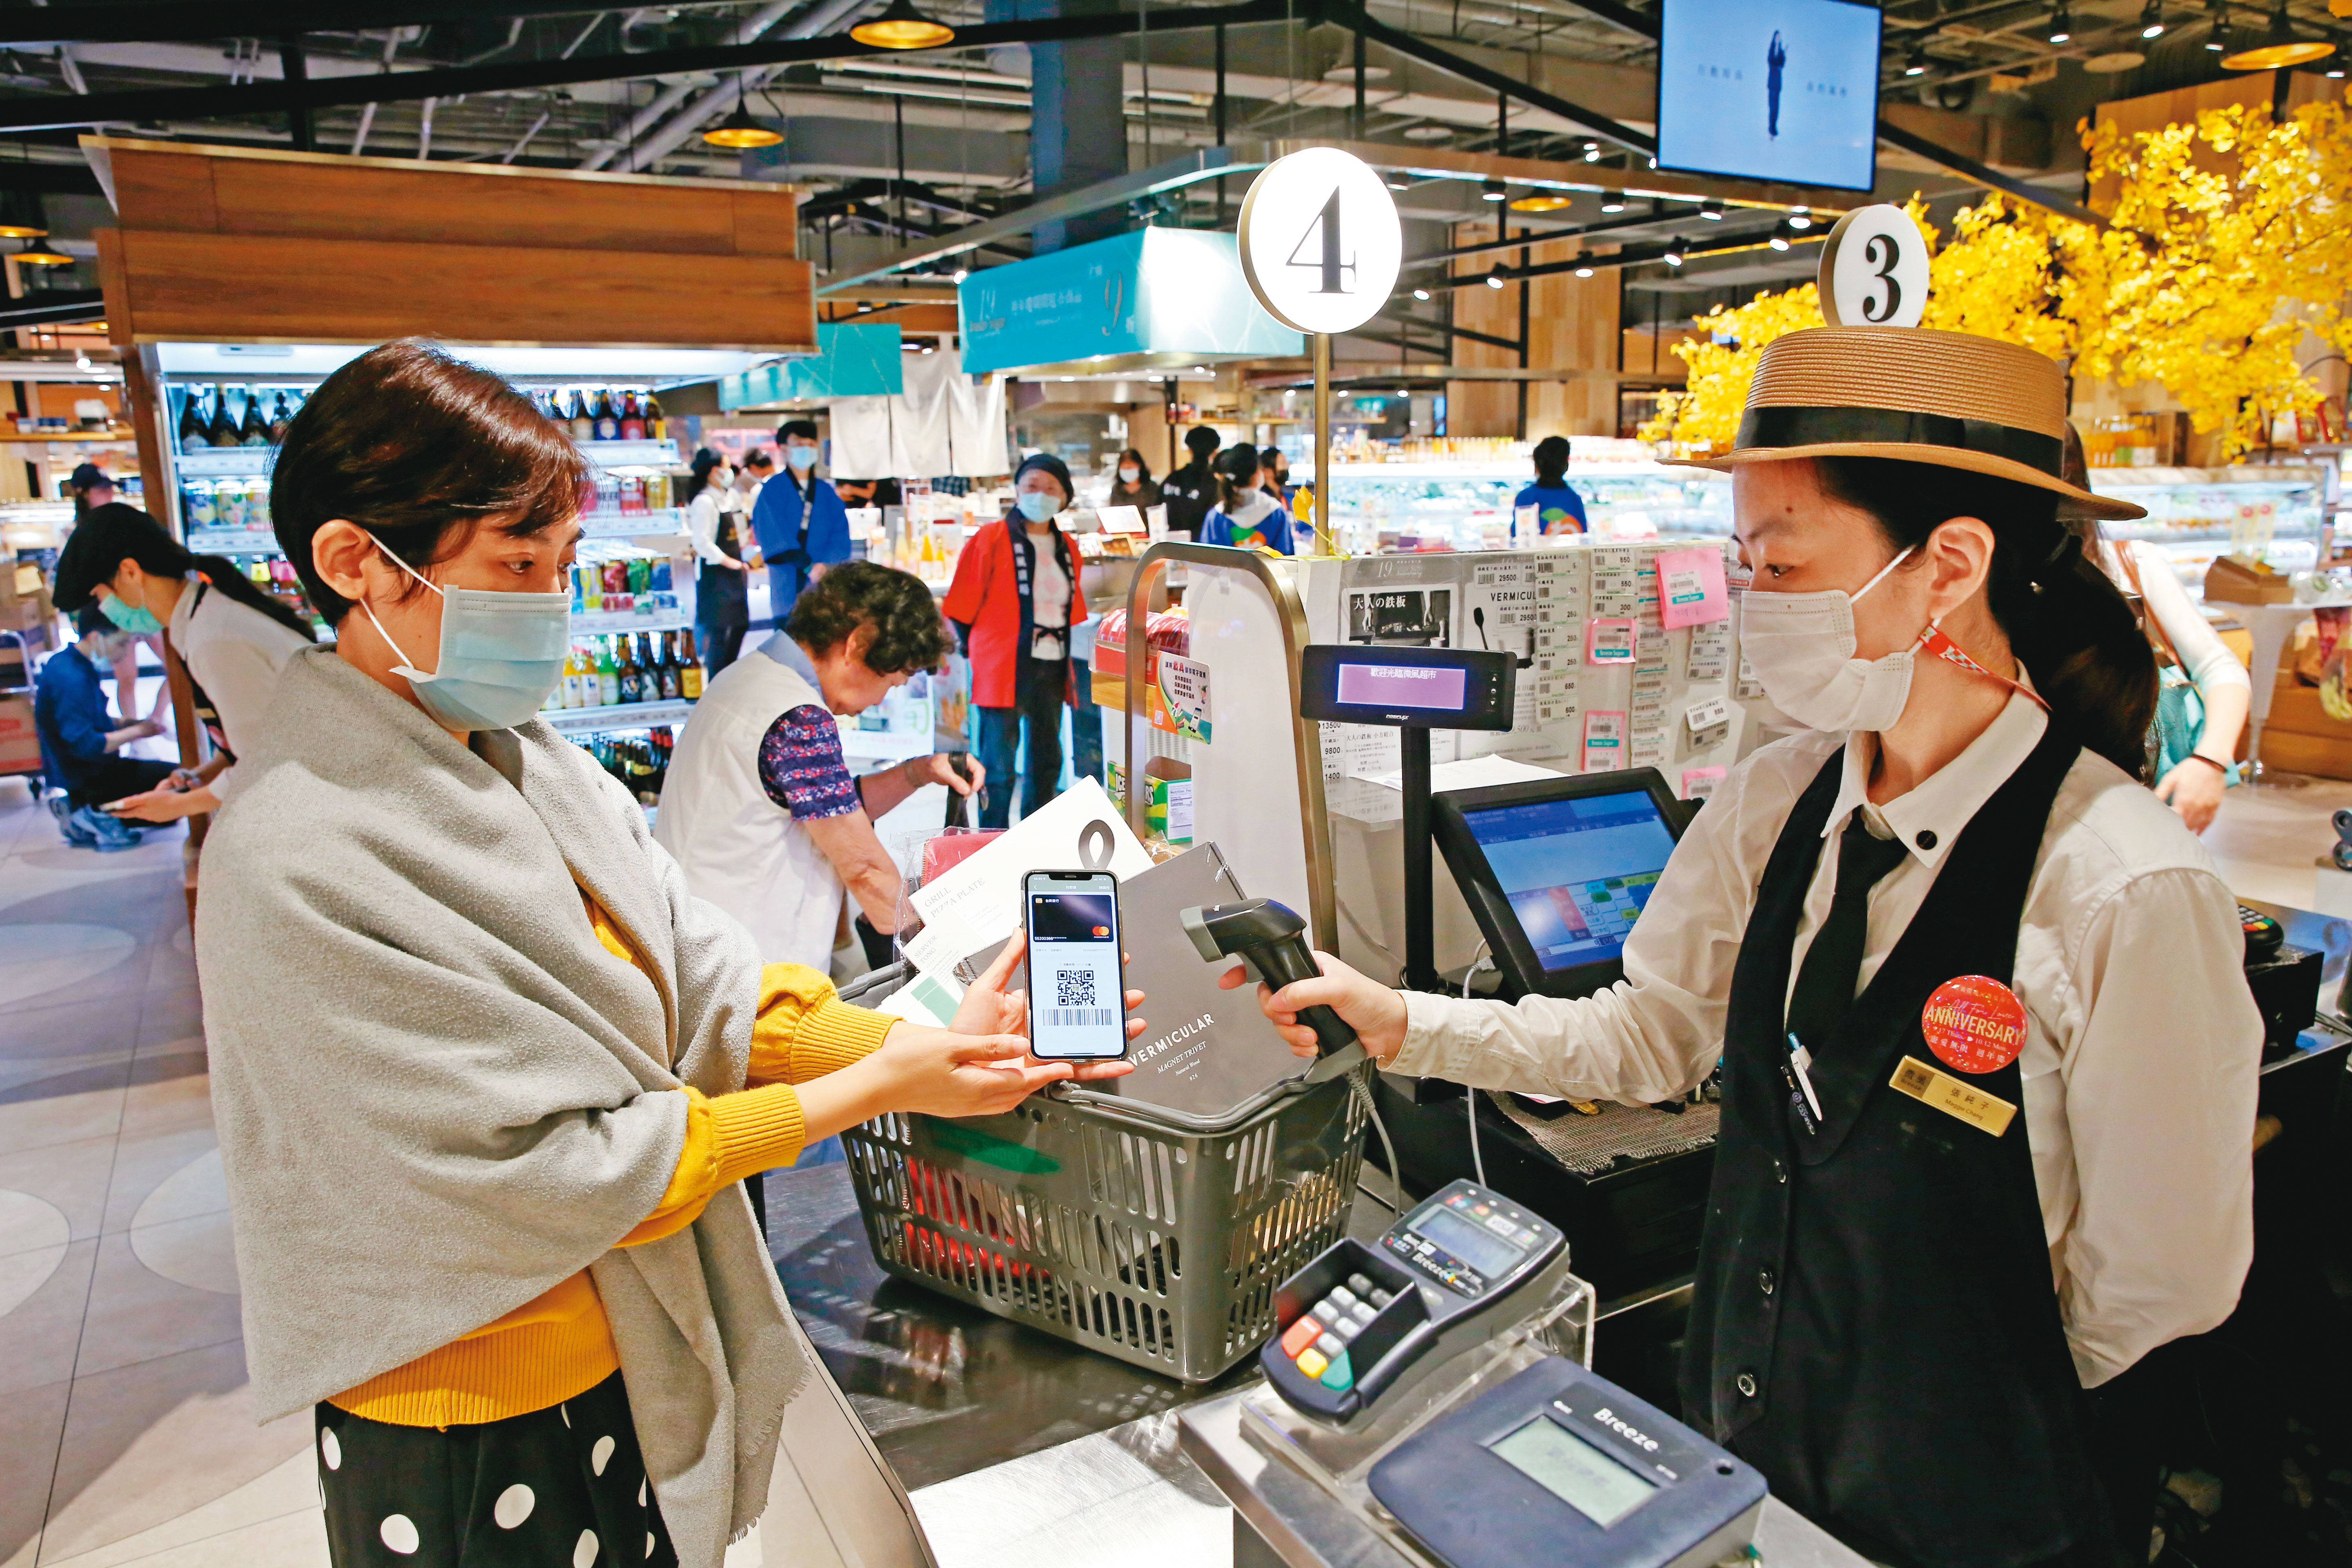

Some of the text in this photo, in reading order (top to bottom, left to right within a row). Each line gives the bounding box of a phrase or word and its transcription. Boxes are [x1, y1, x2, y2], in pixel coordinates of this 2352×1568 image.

[1285, 185, 1356, 294] 4
[1863, 234, 1901, 323] 3
[1377, 561, 1393, 578] 19
[1354, 595, 1406, 610] 大人の鉄板
[1491, 591, 1536, 601] VERMICUL
[1370, 668, 1437, 679] 歡迎光臨微風超市
[1325, 772, 1340, 780] 1400
[924, 887, 951, 907] GRILL
[931, 898, 957, 918] PIZZA
[957, 878, 985, 900] PLATE
[914, 935, 938, 958] SERVER
[920, 947, 937, 964] TONG
[1924, 1004, 2022, 1045] ANNIVERSARY
[1128, 1013, 1215, 1067] VERMICULAR
[1976, 1038, 1991, 1047] 10.12
[1157, 1040, 1207, 1074] MAGNET TRIVET
[1976, 1048, 2006, 1063] 週年慶
[1175, 1058, 1200, 1076] Natural Wood
[1189, 1073, 1198, 1081] #26
[1944, 1099, 1984, 1121] Maggie Chang
[1593, 1408, 1659, 1452] Breeze
